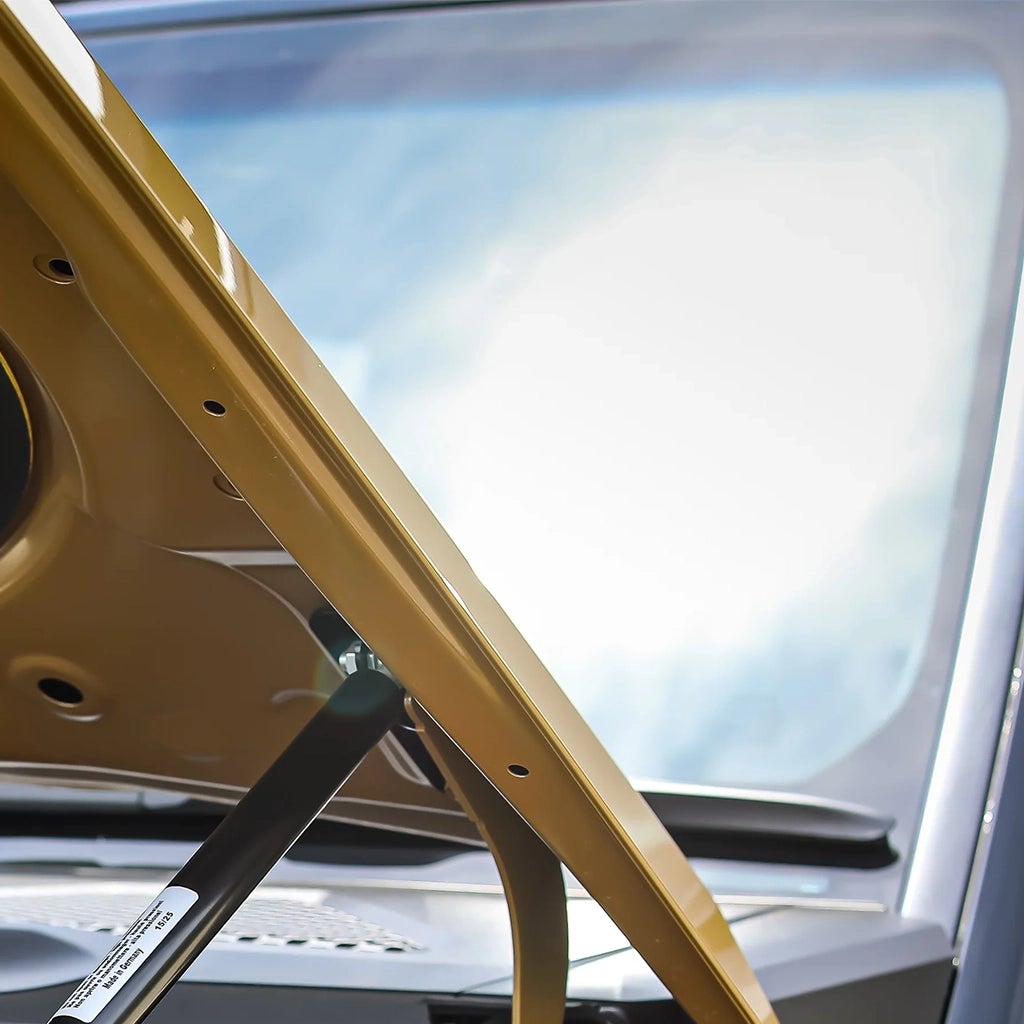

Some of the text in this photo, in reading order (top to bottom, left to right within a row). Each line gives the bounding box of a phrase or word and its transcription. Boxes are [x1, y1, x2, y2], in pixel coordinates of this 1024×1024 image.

[155, 911, 173, 930] 15/25
[102, 974, 118, 989] Made
[120, 948, 144, 969] Germany
